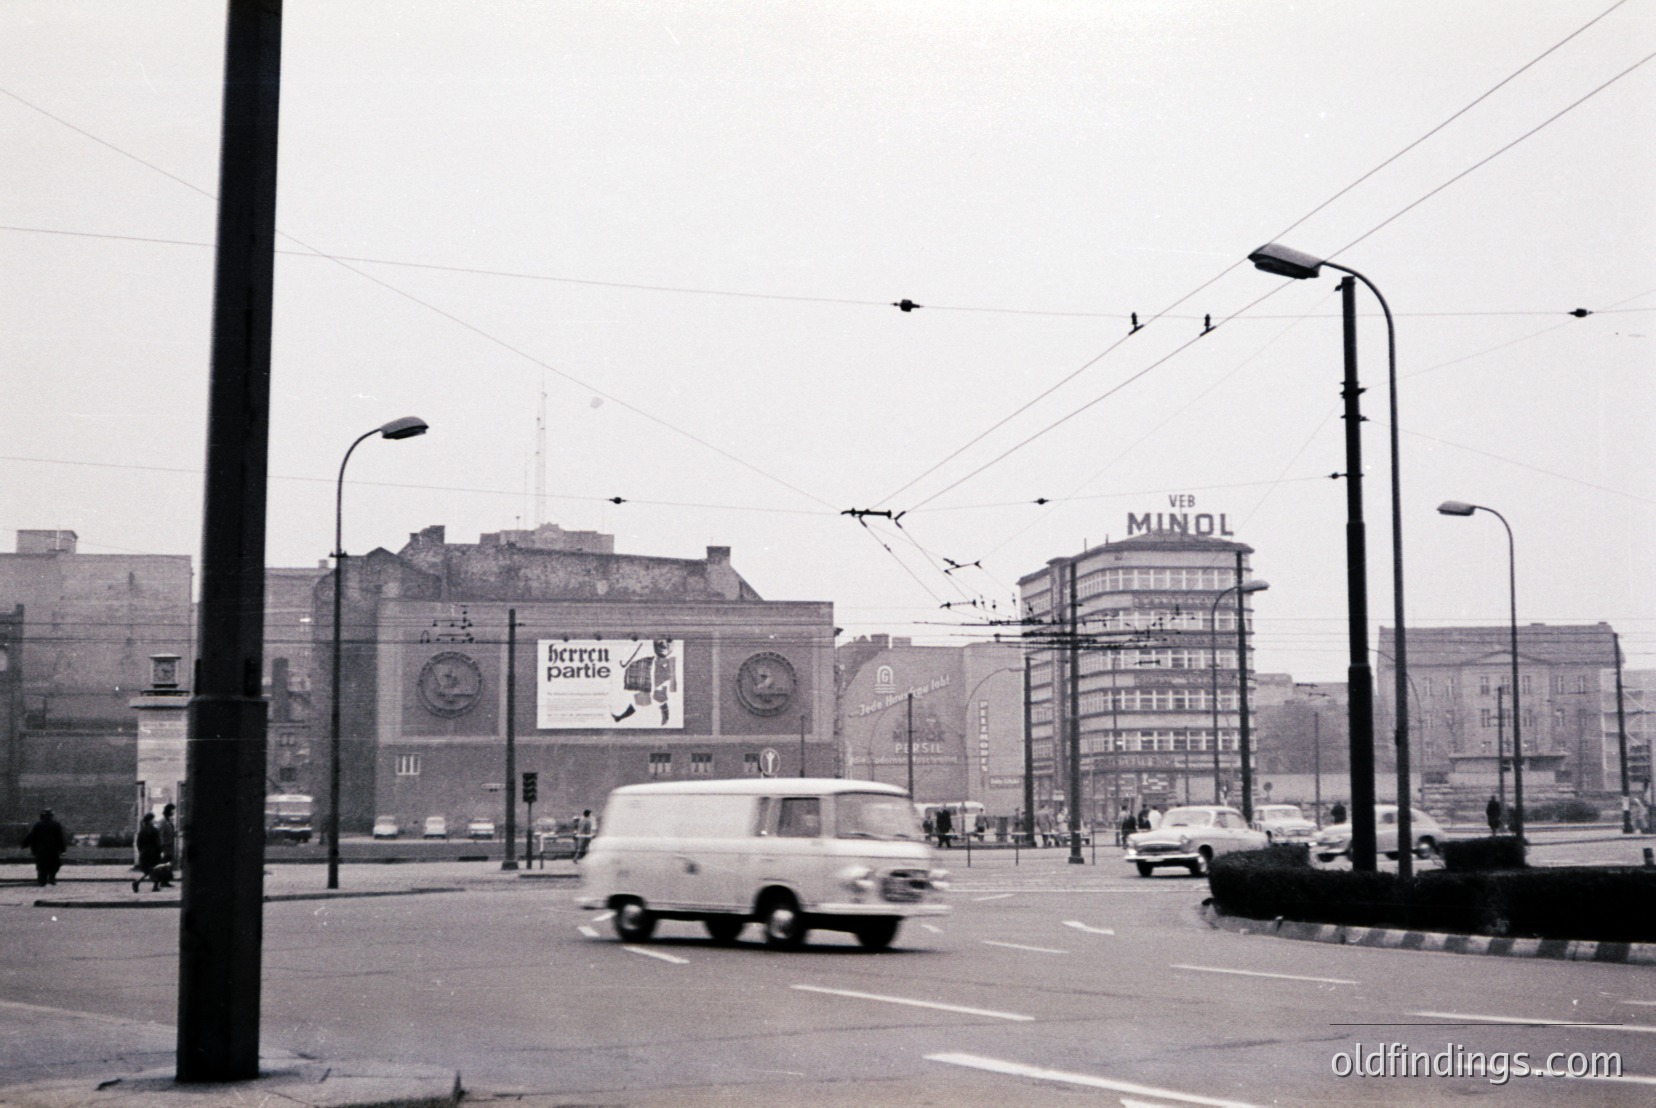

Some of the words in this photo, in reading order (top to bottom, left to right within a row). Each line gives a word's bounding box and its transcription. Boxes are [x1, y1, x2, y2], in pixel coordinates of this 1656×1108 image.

[1168, 494, 1196, 508] VEB
[1127, 512, 1235, 537] MINOL
[547, 643, 610, 665] herren
[546, 662, 611, 682] partie
[858, 699, 882, 716] Jede
[894, 742, 944, 754] PERSIL
